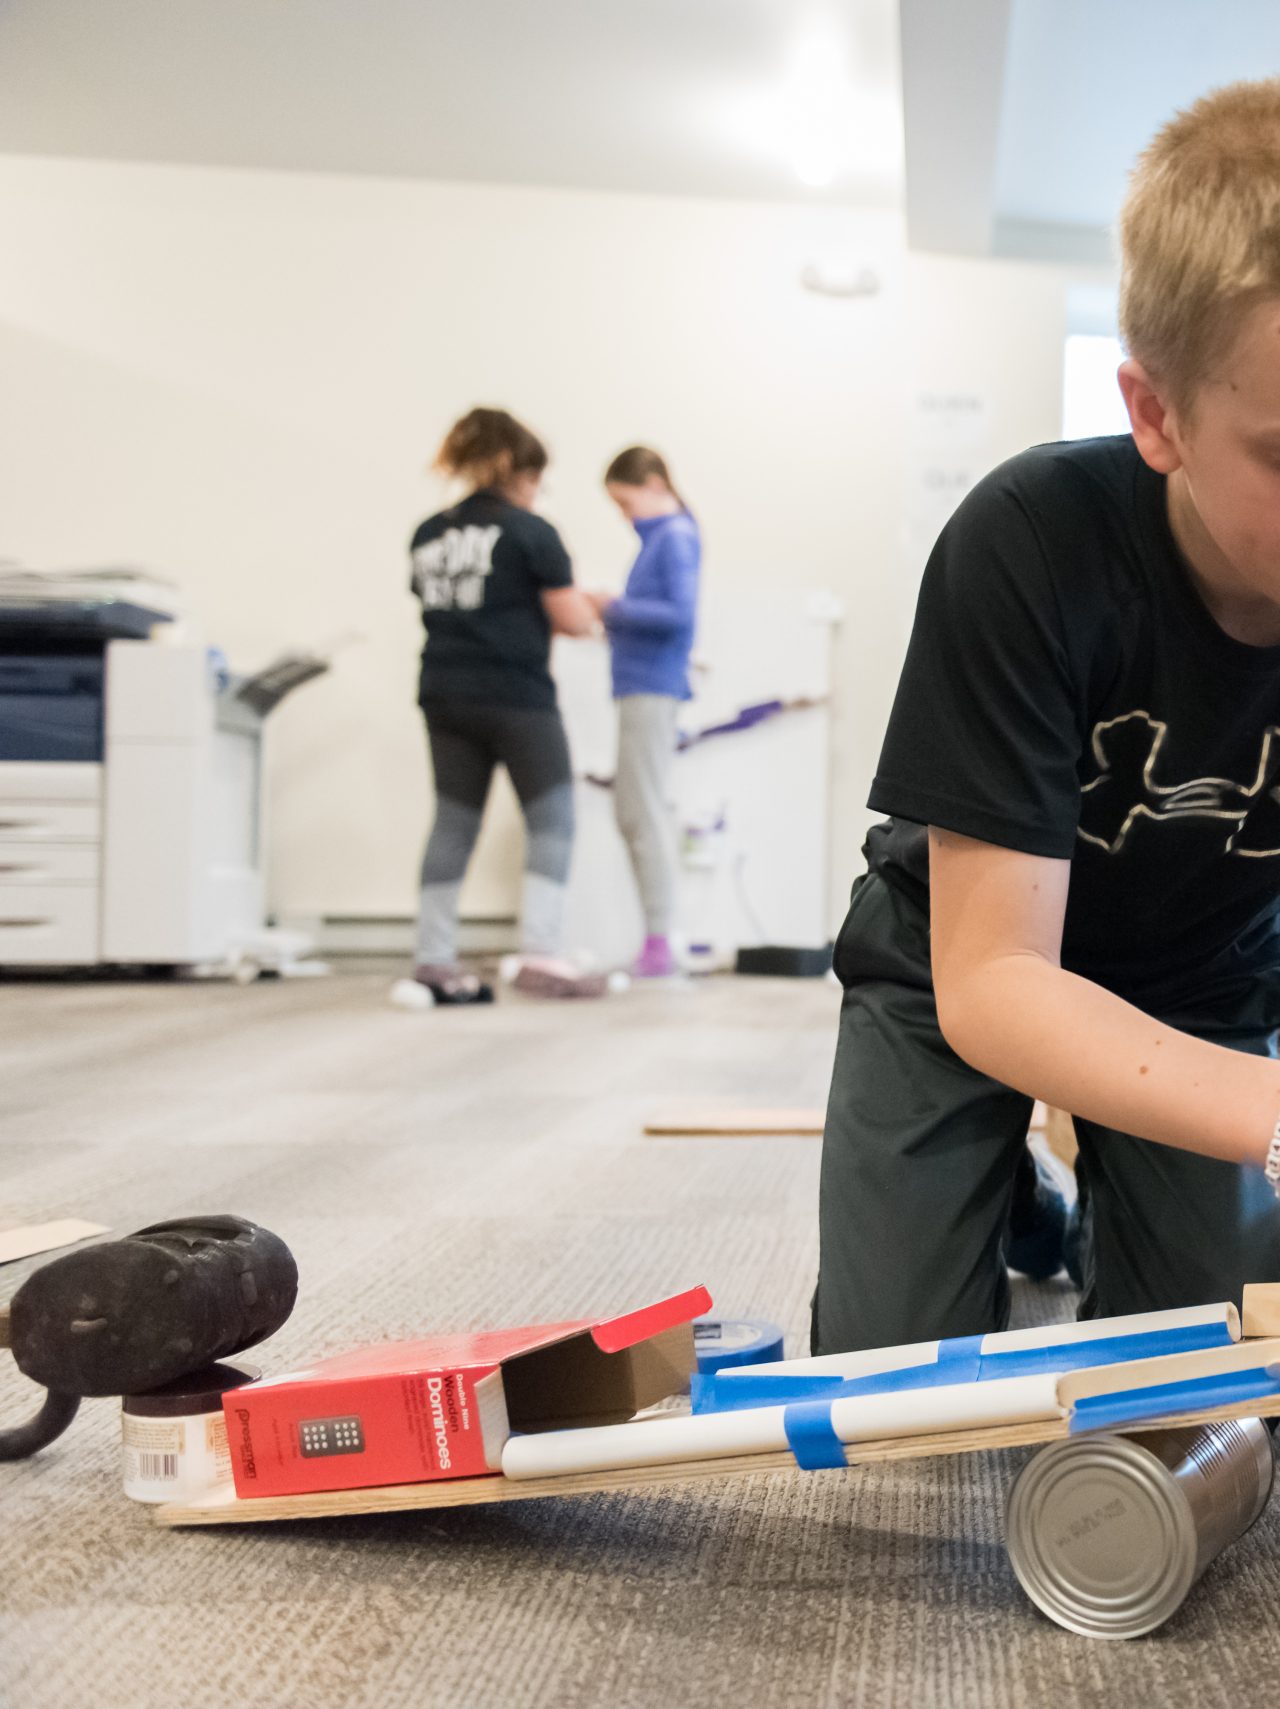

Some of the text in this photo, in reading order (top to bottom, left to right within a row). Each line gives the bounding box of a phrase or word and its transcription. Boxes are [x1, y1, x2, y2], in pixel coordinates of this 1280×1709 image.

[427, 1377, 452, 1470] Dominoes
[444, 1375, 459, 1433] Wooden
[455, 1373, 470, 1430] Double Nine
